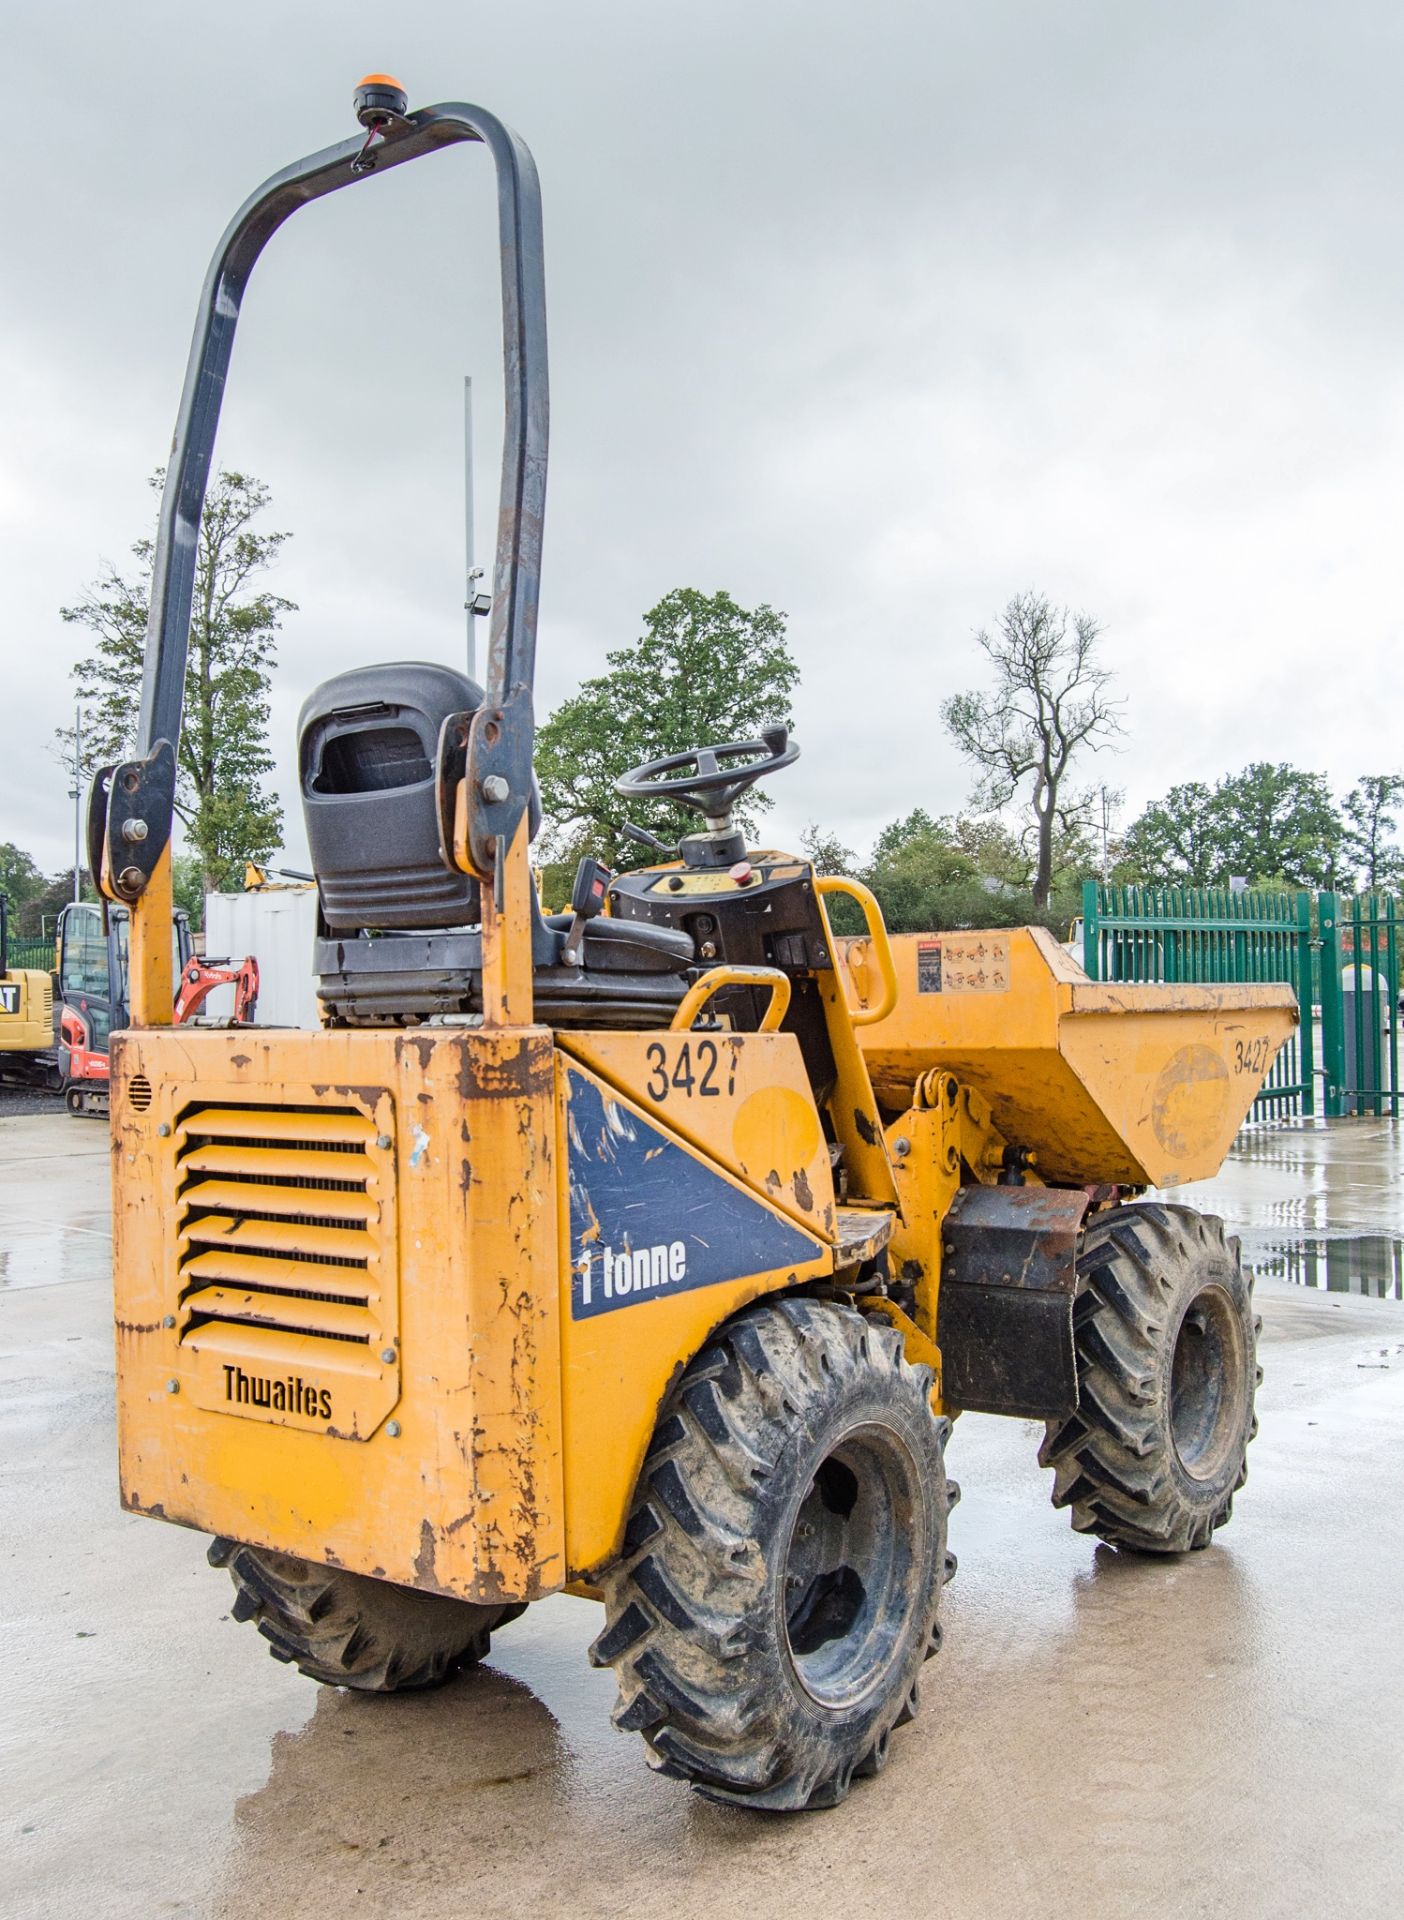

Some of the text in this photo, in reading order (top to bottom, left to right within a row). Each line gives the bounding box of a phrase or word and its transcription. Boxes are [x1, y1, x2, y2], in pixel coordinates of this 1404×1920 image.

[647, 1036, 744, 1102] 3427
[1234, 1036, 1269, 1075] 3427
[578, 1241, 686, 1305] 1 tonne
[223, 1365, 332, 1420] Thwaites
